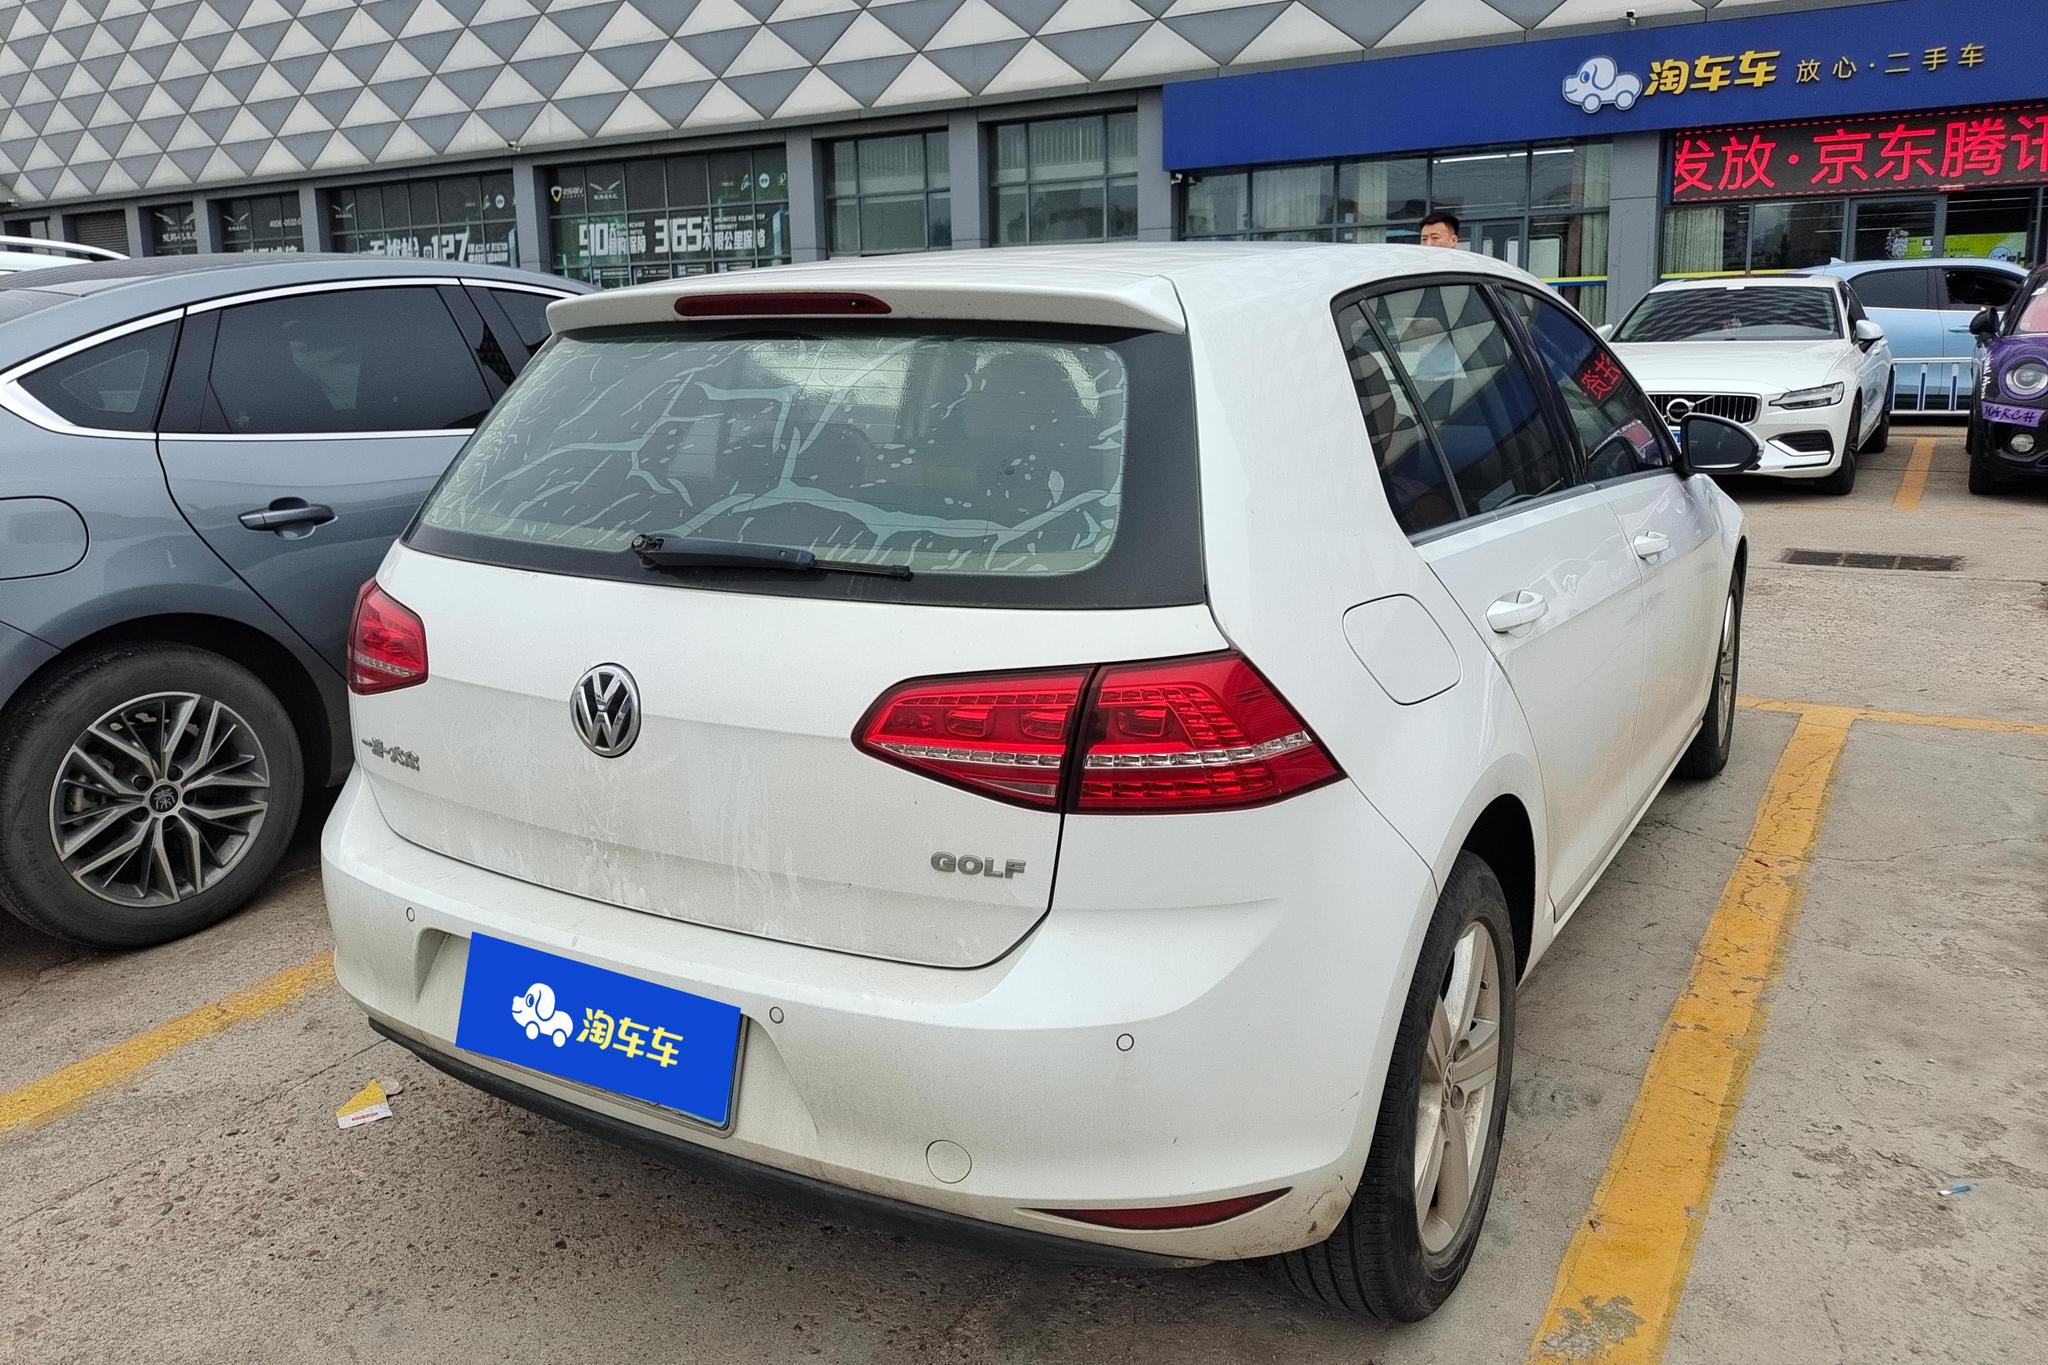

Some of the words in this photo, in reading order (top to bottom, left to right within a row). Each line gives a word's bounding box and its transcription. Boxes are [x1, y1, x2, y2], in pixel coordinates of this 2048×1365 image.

[1643, 50, 1781, 96] 淘车车
[654, 217, 702, 253] 365
[930, 851, 1026, 878] GOLF
